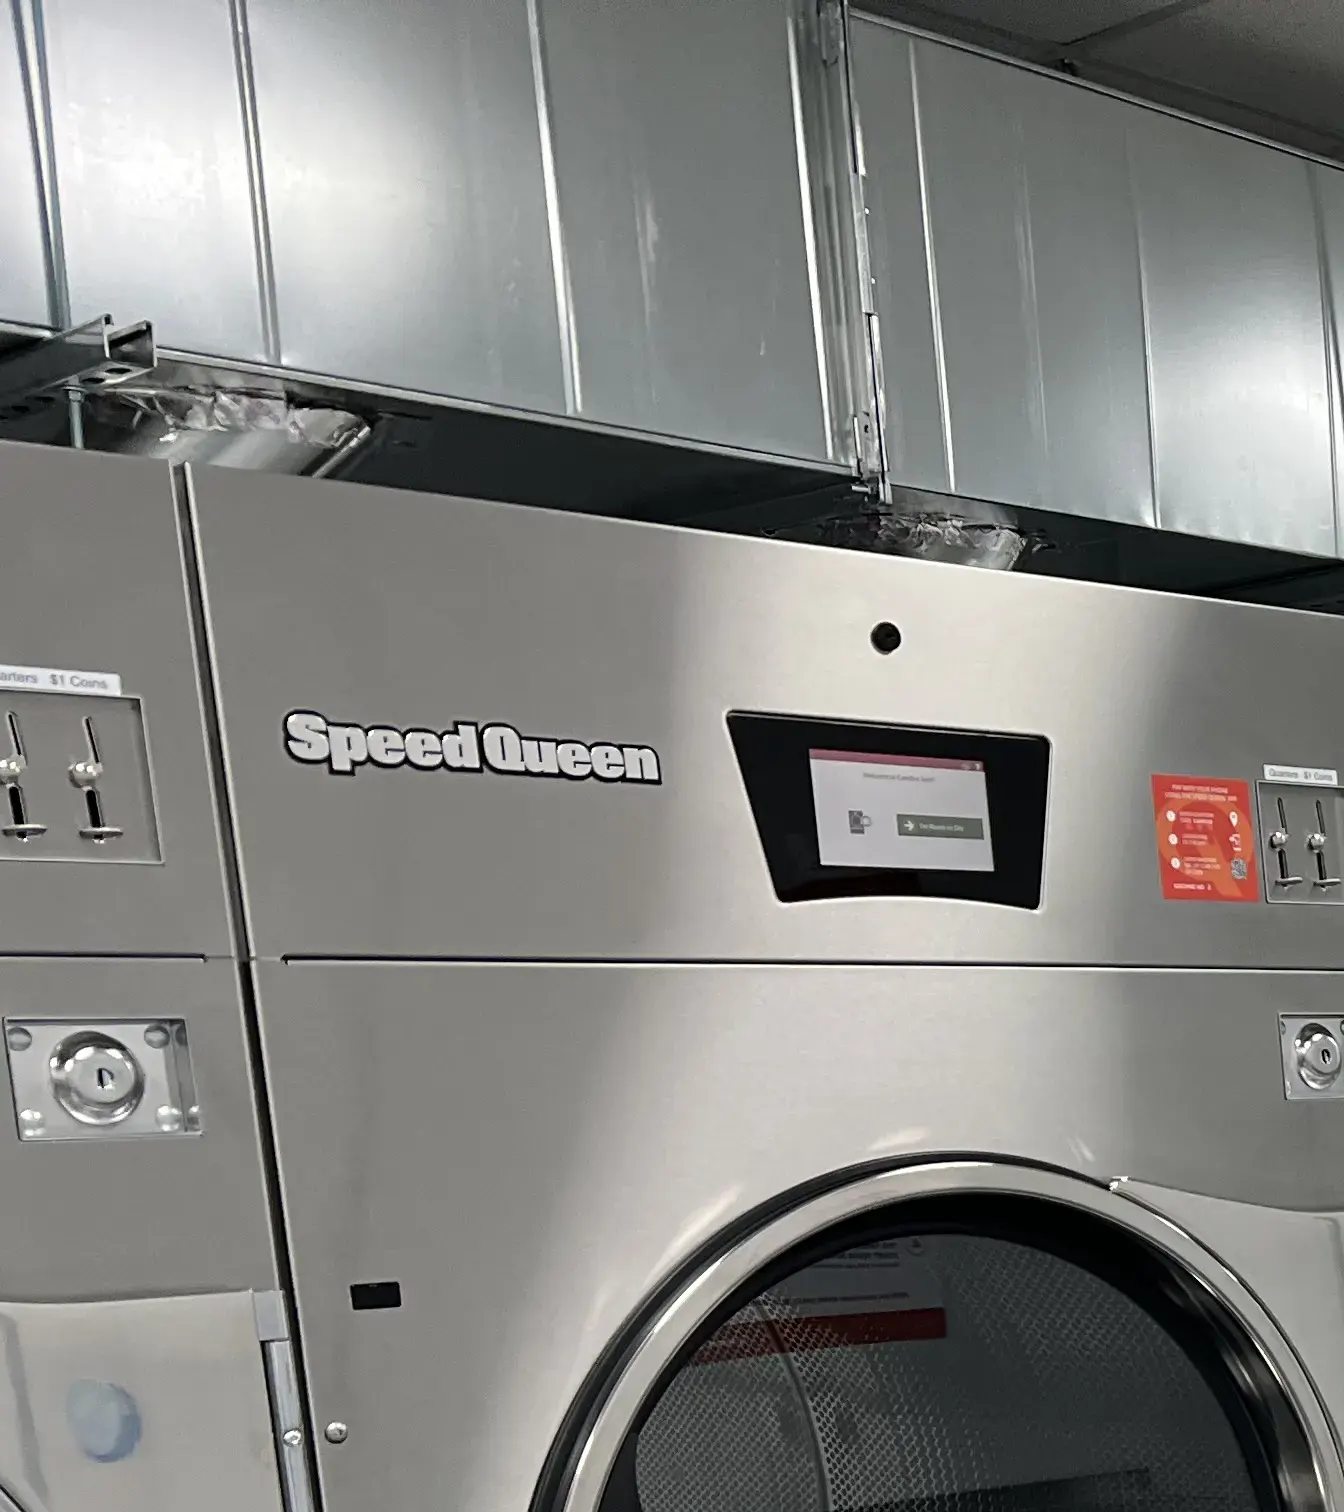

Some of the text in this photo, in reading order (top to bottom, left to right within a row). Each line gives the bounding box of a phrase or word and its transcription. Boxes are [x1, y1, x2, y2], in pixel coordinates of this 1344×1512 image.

[49, 673, 65, 686] $1
[69, 675, 108, 690] Coins
[283, 709, 662, 785] Speed Queen
